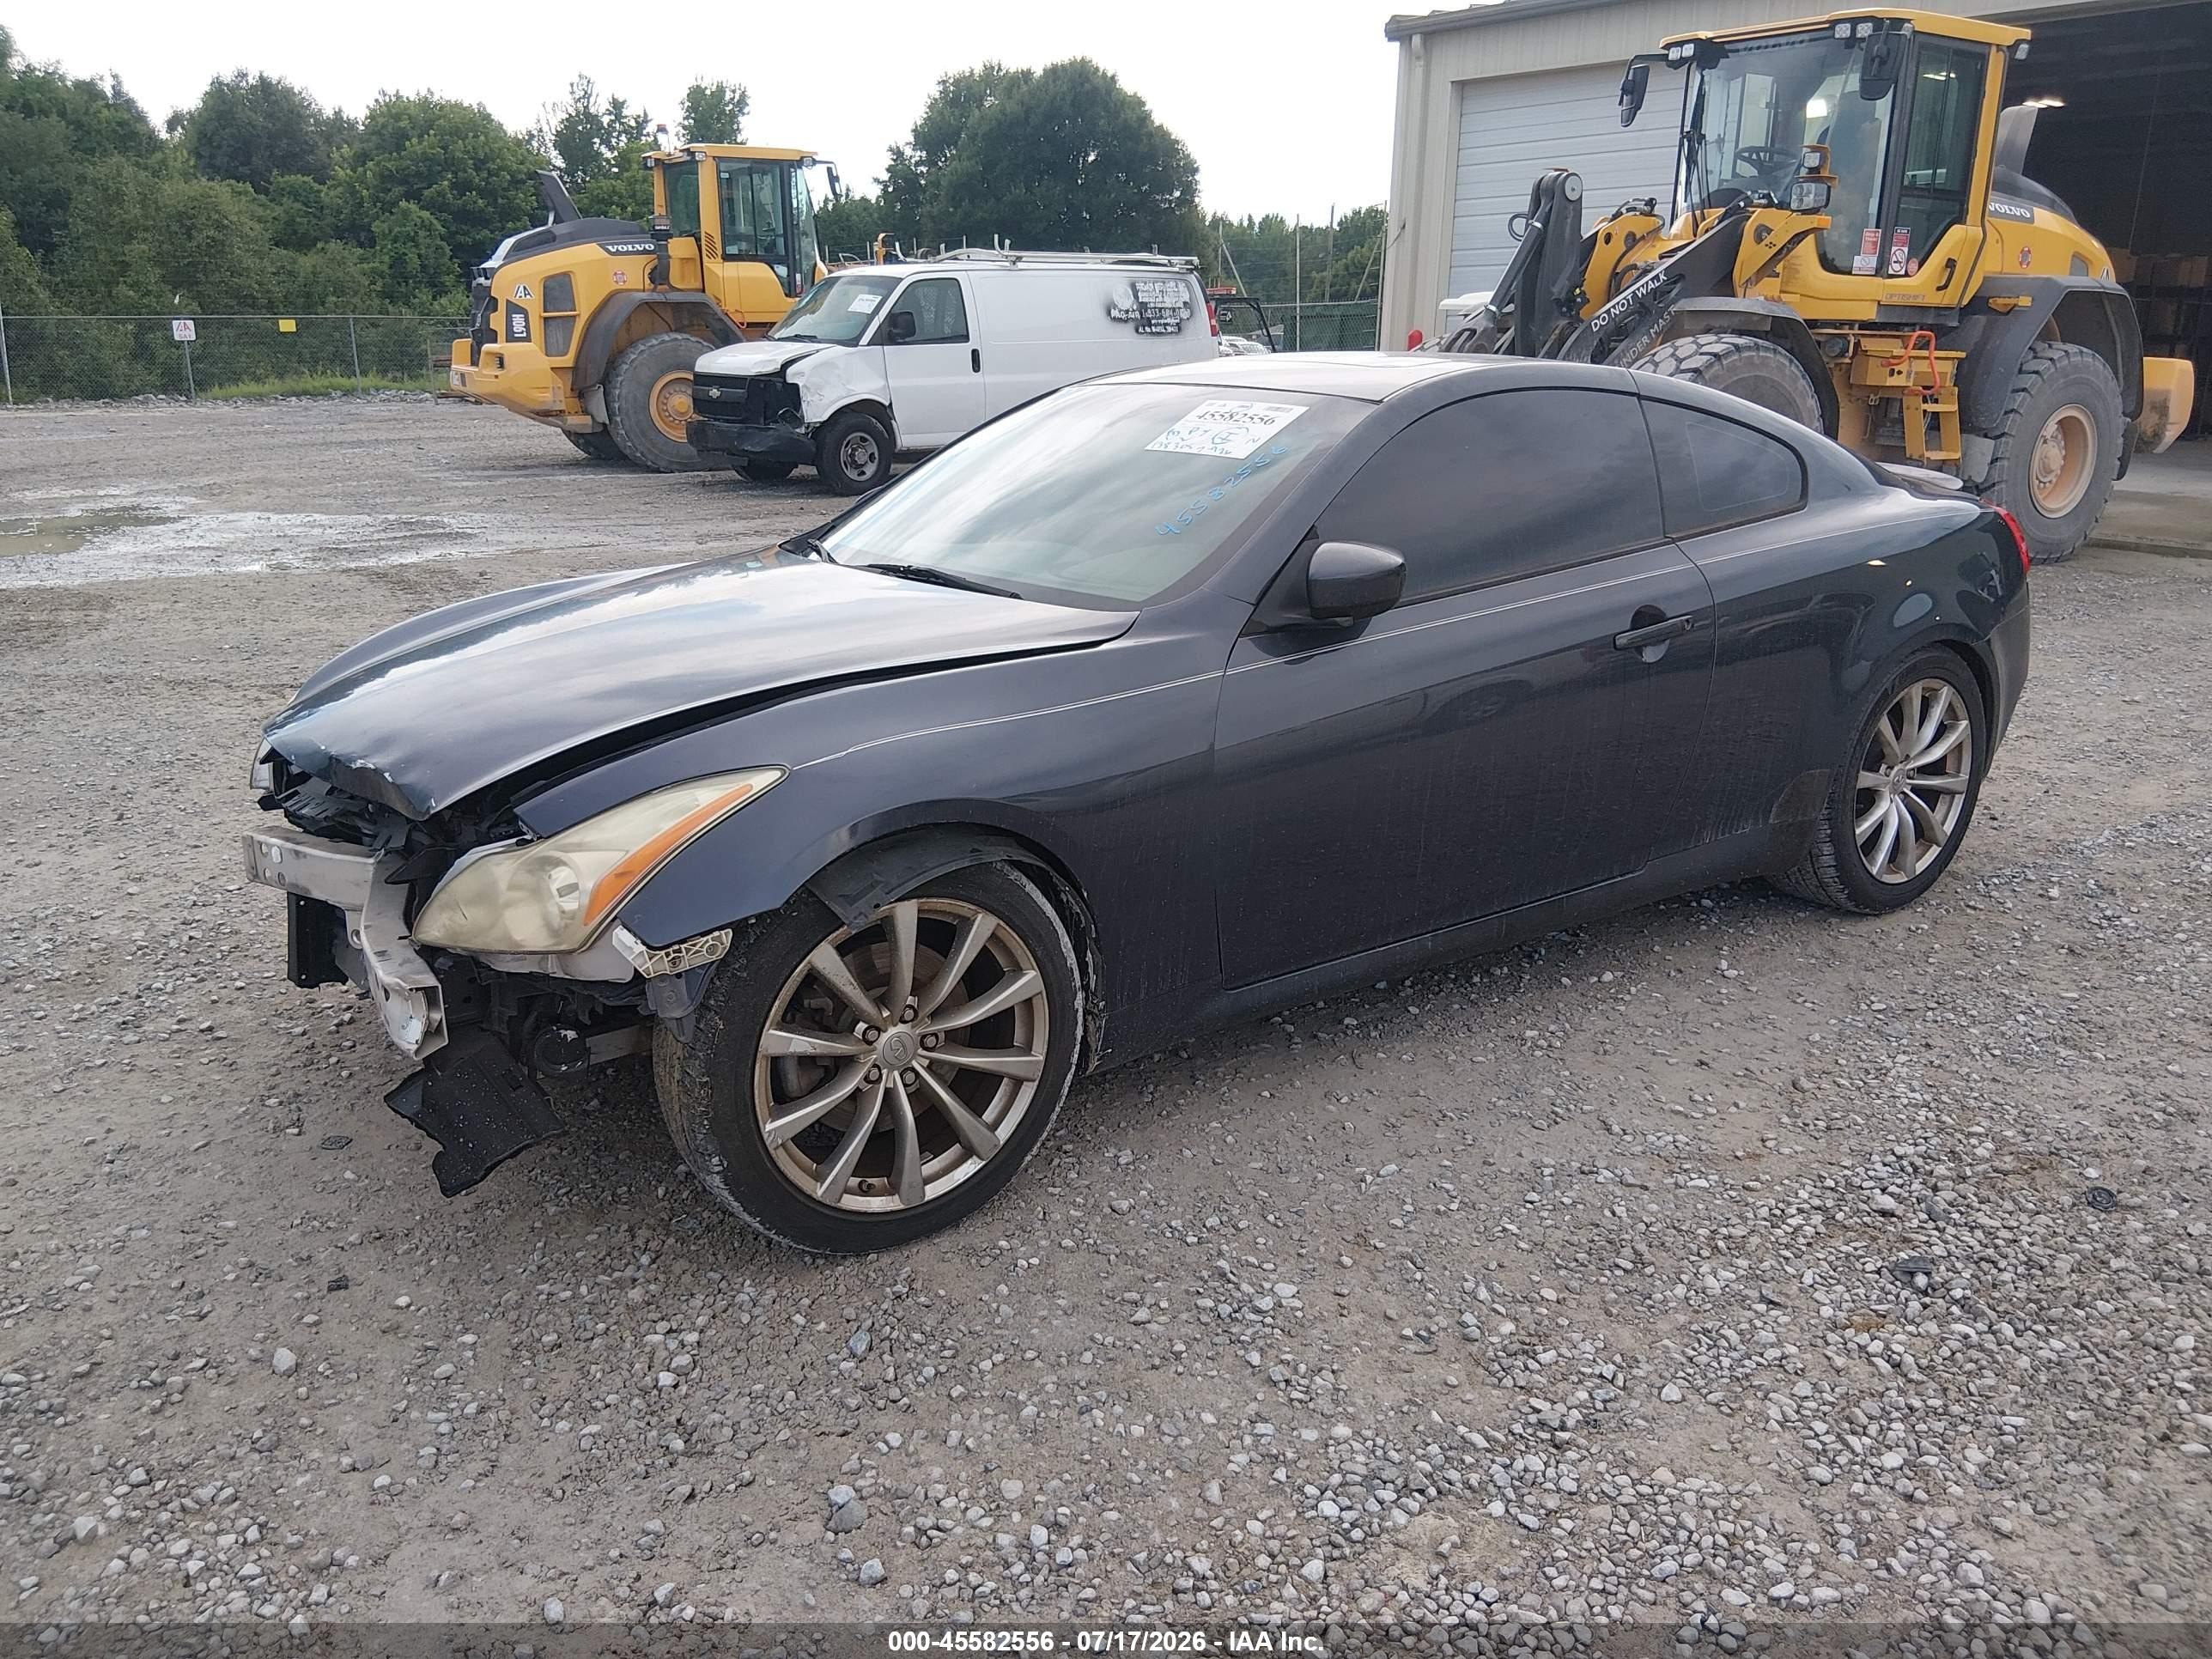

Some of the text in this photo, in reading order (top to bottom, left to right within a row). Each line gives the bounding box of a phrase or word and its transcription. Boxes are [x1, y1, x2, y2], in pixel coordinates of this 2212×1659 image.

[605, 243, 655, 252] VOLVO
[1590, 270, 1668, 332] DO NOT WALK
[511, 313, 527, 337] L90H
[1650, 305, 1676, 338] MAST
[1196, 410, 1279, 426] 45582556
[1155, 446, 1288, 536] 45582556
